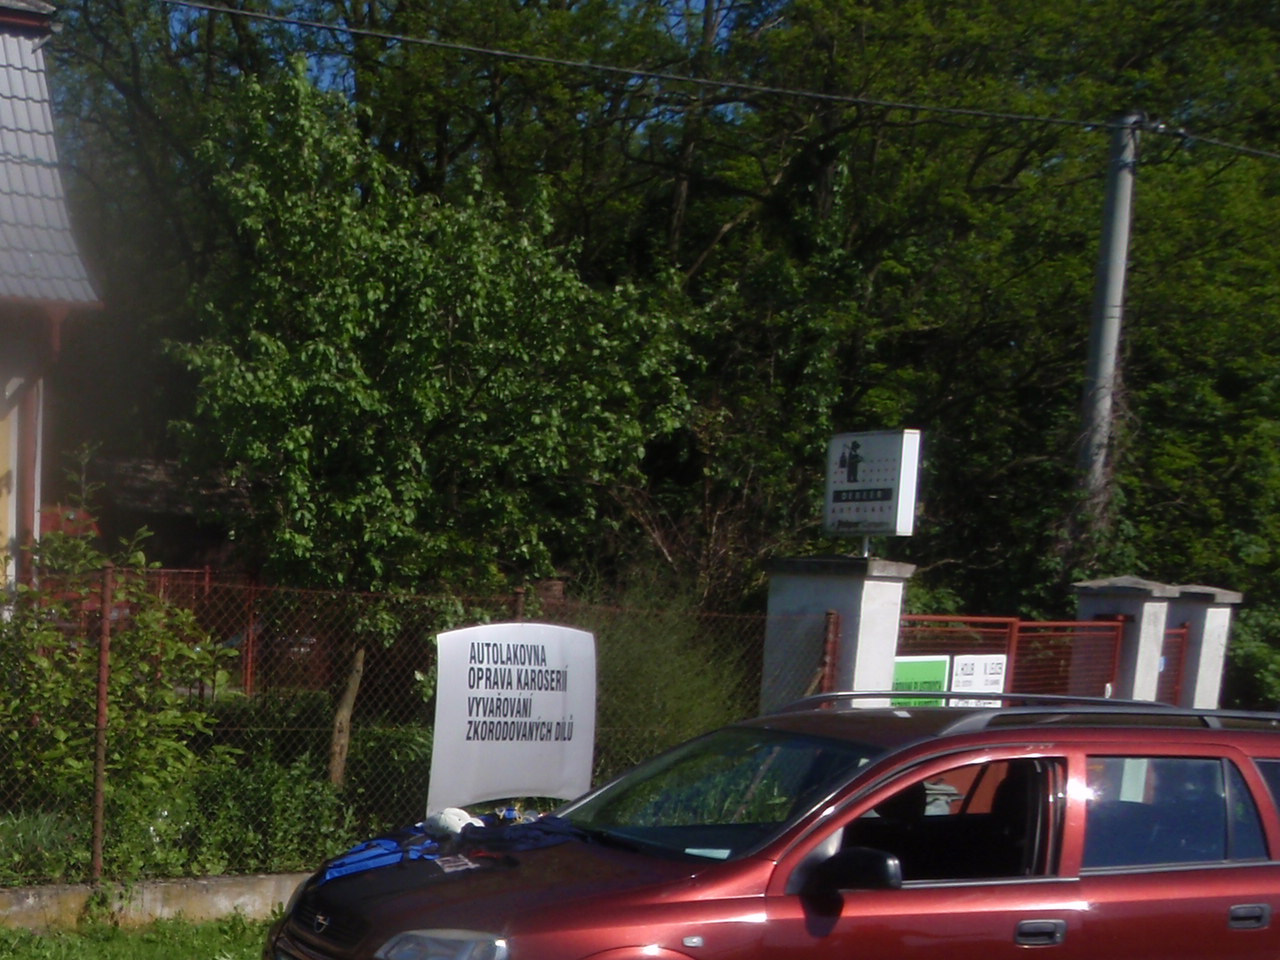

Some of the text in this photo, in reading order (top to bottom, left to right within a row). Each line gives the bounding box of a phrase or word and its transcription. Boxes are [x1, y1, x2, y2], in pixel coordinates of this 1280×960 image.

[469, 642, 547, 666] AUTOLAKOVNA
[468, 666, 513, 690] OPRAVA
[466, 716, 552, 742] ZKORODOVANÝCH
